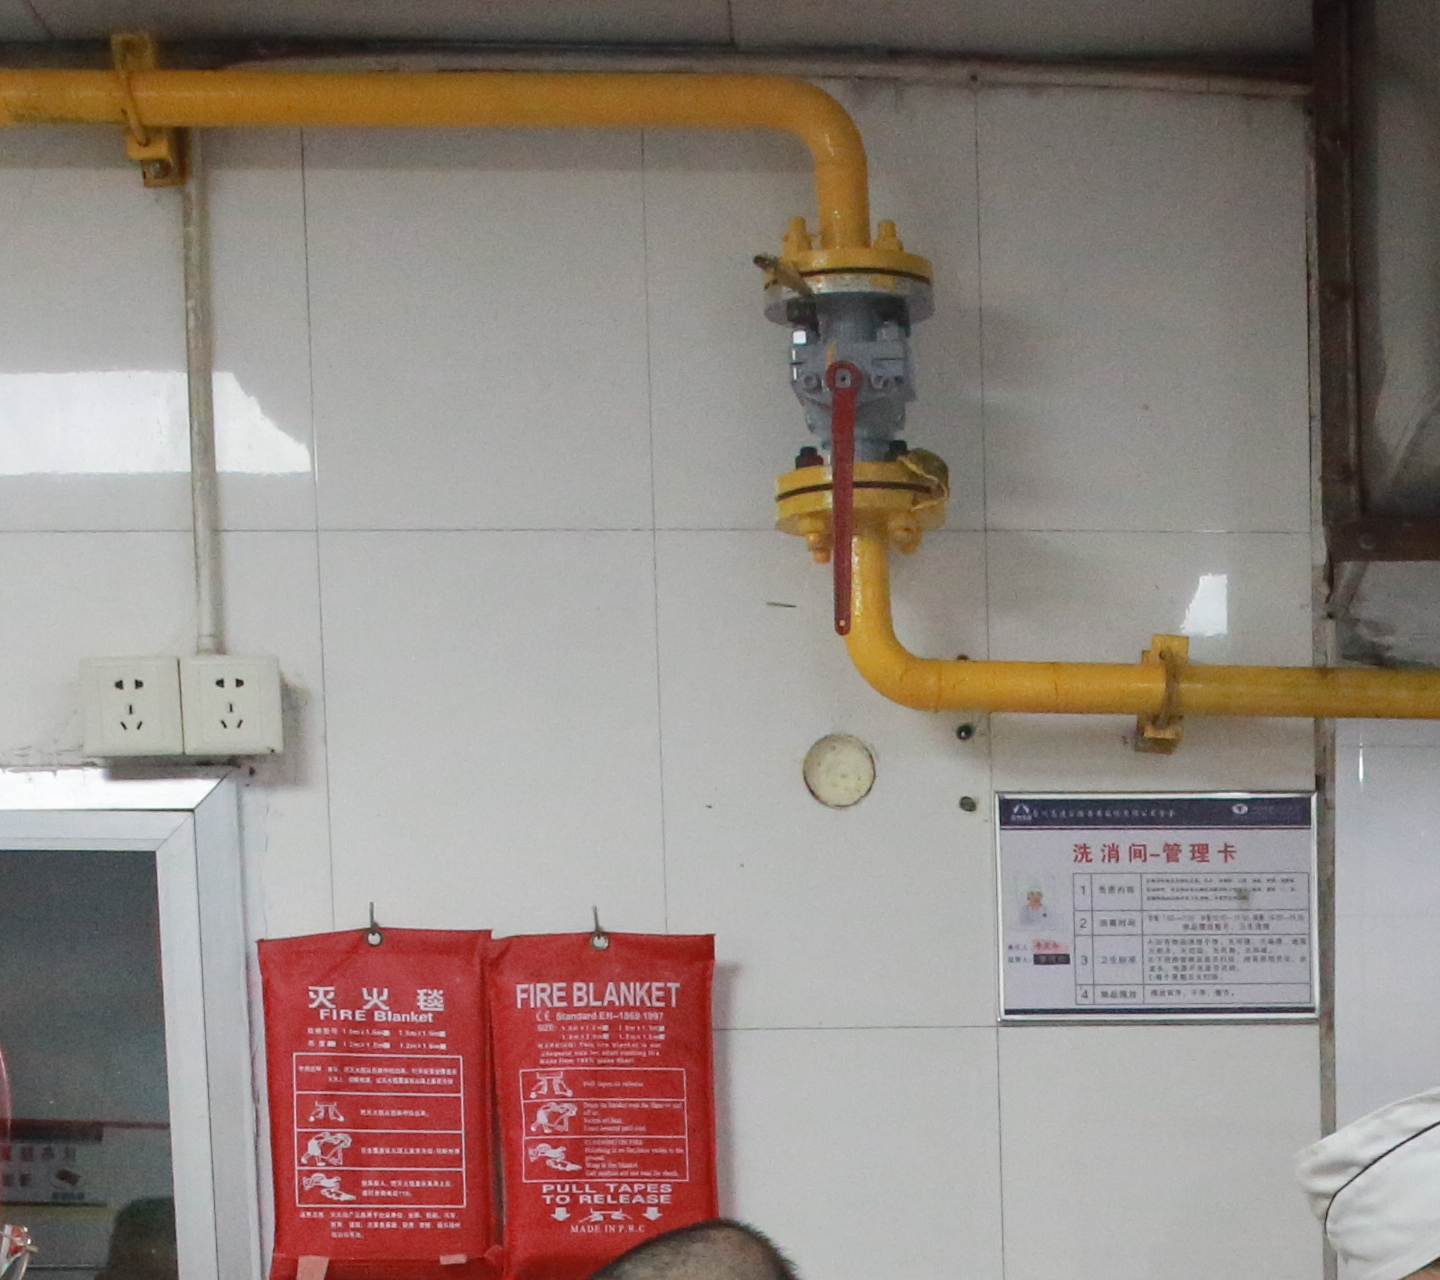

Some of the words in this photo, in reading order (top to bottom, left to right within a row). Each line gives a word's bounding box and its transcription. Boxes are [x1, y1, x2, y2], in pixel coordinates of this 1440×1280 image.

[1072, 842, 1238, 863] 洗消间-管理卡
[1080, 885, 1087, 896] 1
[1080, 918, 1088, 929] 2
[1080, 954, 1088, 966] 3
[307, 985, 446, 1012] 灭火毯
[516, 982, 568, 1008] FIRE
[573, 981, 680, 1008] BLANKET
[1081, 988, 1089, 1000] 4
[319, 1009, 367, 1022] FIRE
[374, 1009, 435, 1024] Blanket
[542, 1184, 597, 1194] PULL
[606, 1183, 673, 1194] TAPES
[542, 1195, 571, 1205] TO
[579, 1194, 672, 1205] RELEASE
[570, 1225, 600, 1234] MADE
[605, 1225, 616, 1233] IN
